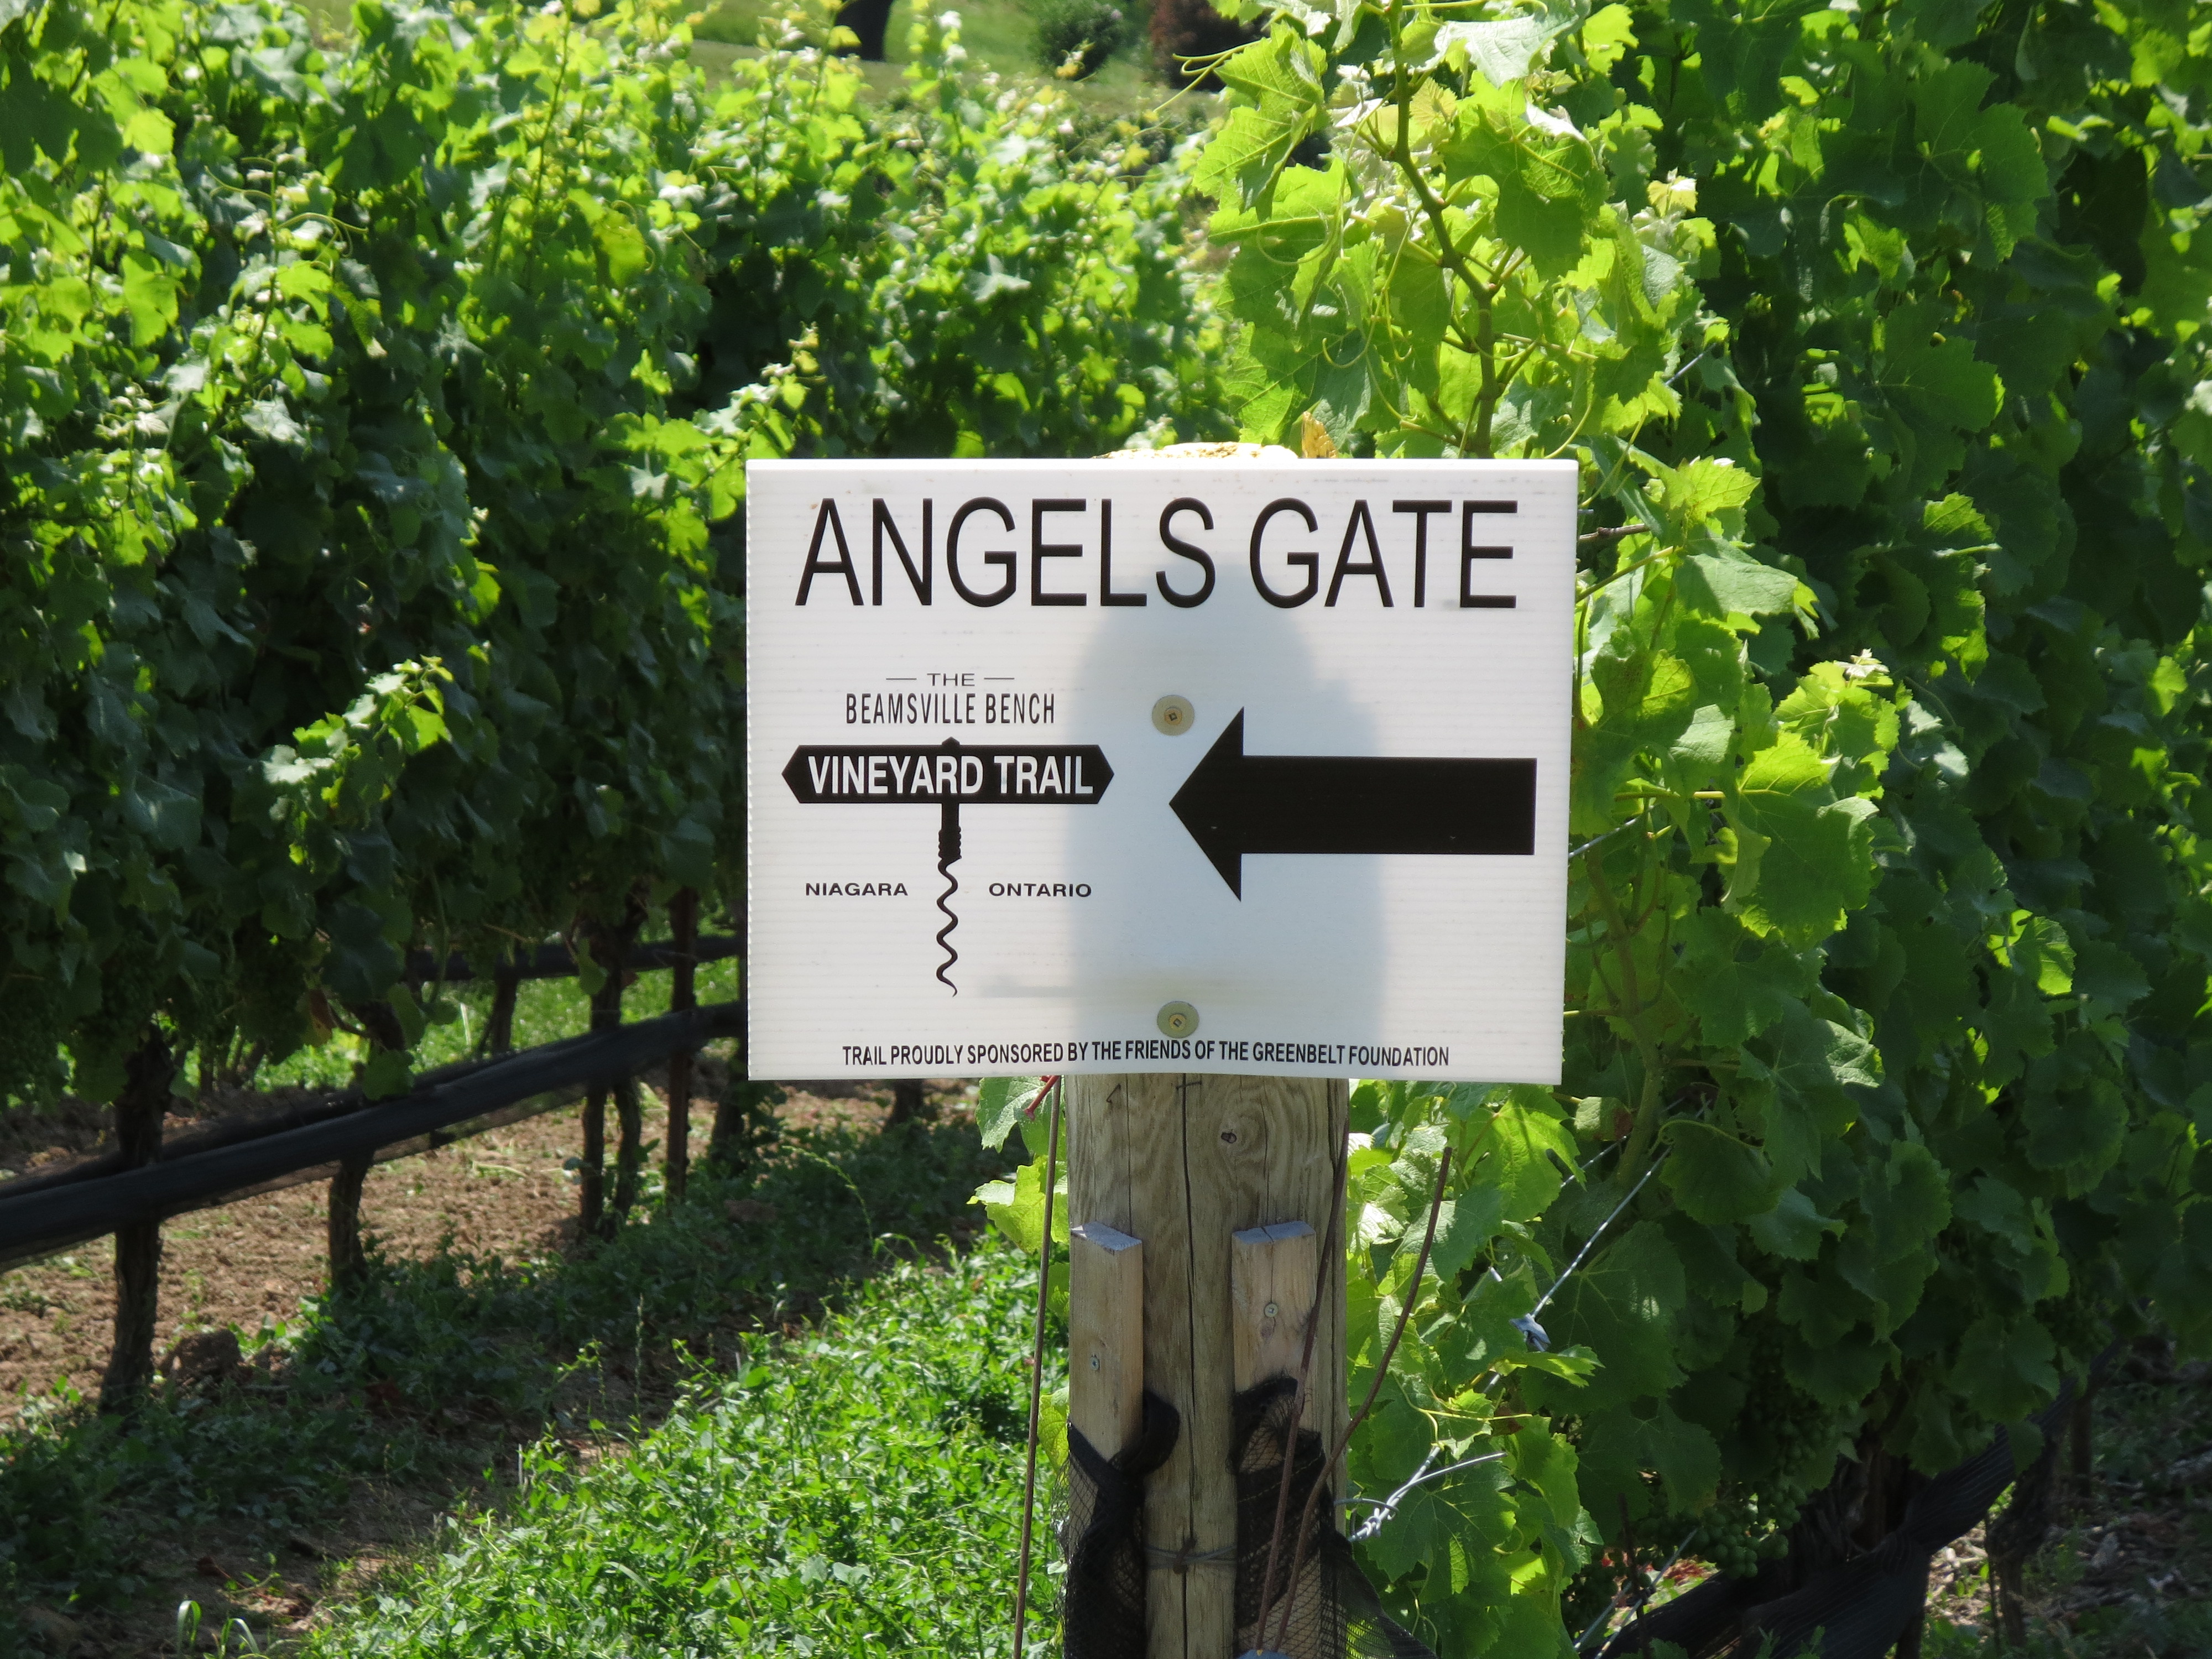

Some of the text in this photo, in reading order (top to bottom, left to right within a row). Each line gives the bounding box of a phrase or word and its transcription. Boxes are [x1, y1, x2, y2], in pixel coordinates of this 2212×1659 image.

[796, 497, 1517, 609] ANGELS GATE
[928, 673, 975, 687] THE
[846, 693, 1054, 724] BEAMSVILLE BENCH
[808, 755, 1093, 795] VINEYARD TRAIL
[805, 883, 908, 896] NIAGARA
[988, 883, 1092, 898] ONTARIO
[842, 1040, 1449, 1067] TRAIL PROUDLY SPONSORED BY THE FRIENDS OF THE GREENBELT FOUNDATION
